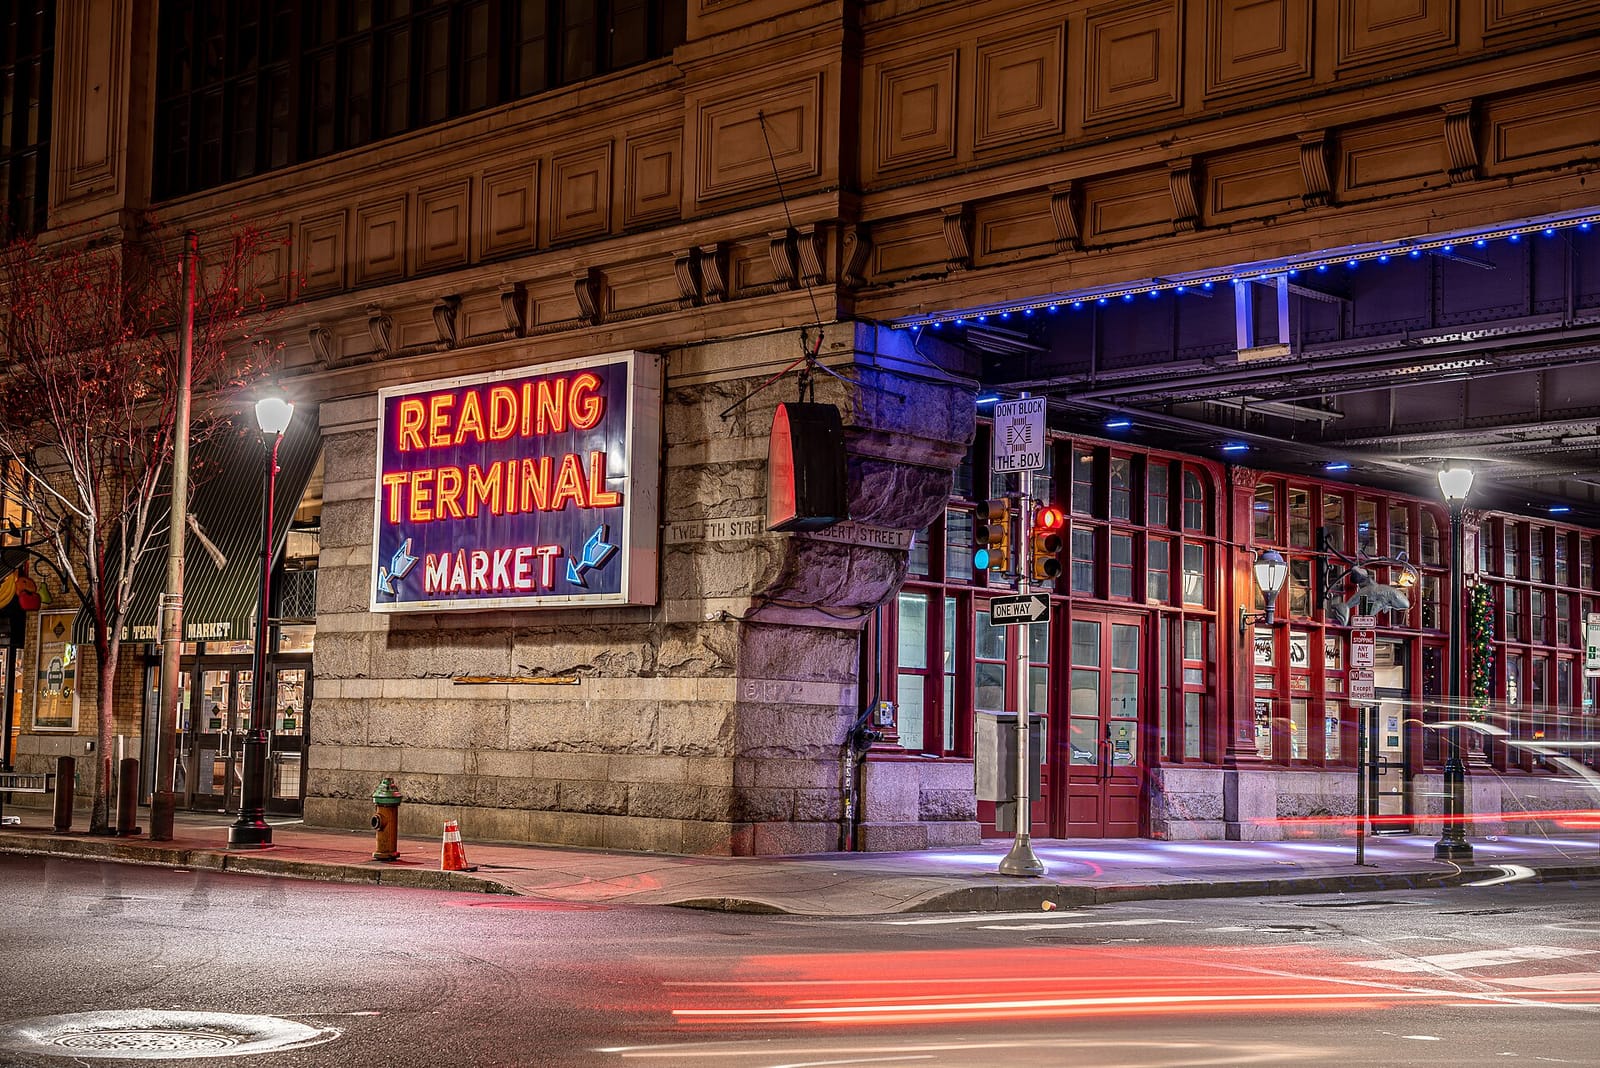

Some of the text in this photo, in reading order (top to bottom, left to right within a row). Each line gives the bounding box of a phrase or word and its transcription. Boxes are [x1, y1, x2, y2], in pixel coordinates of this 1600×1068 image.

[399, 372, 602, 451] READING
[1018, 400, 1043, 415] BLOCK
[997, 452, 1041, 469] THE BOX
[382, 450, 623, 524] TERMINAL
[730, 519, 764, 536] STREE
[860, 527, 903, 546] STREET
[424, 545, 562, 593] MARKET
[996, 603, 1031, 617] ONE WAY
[188, 622, 231, 639] MARKET
[1351, 671, 1359, 680] NO
